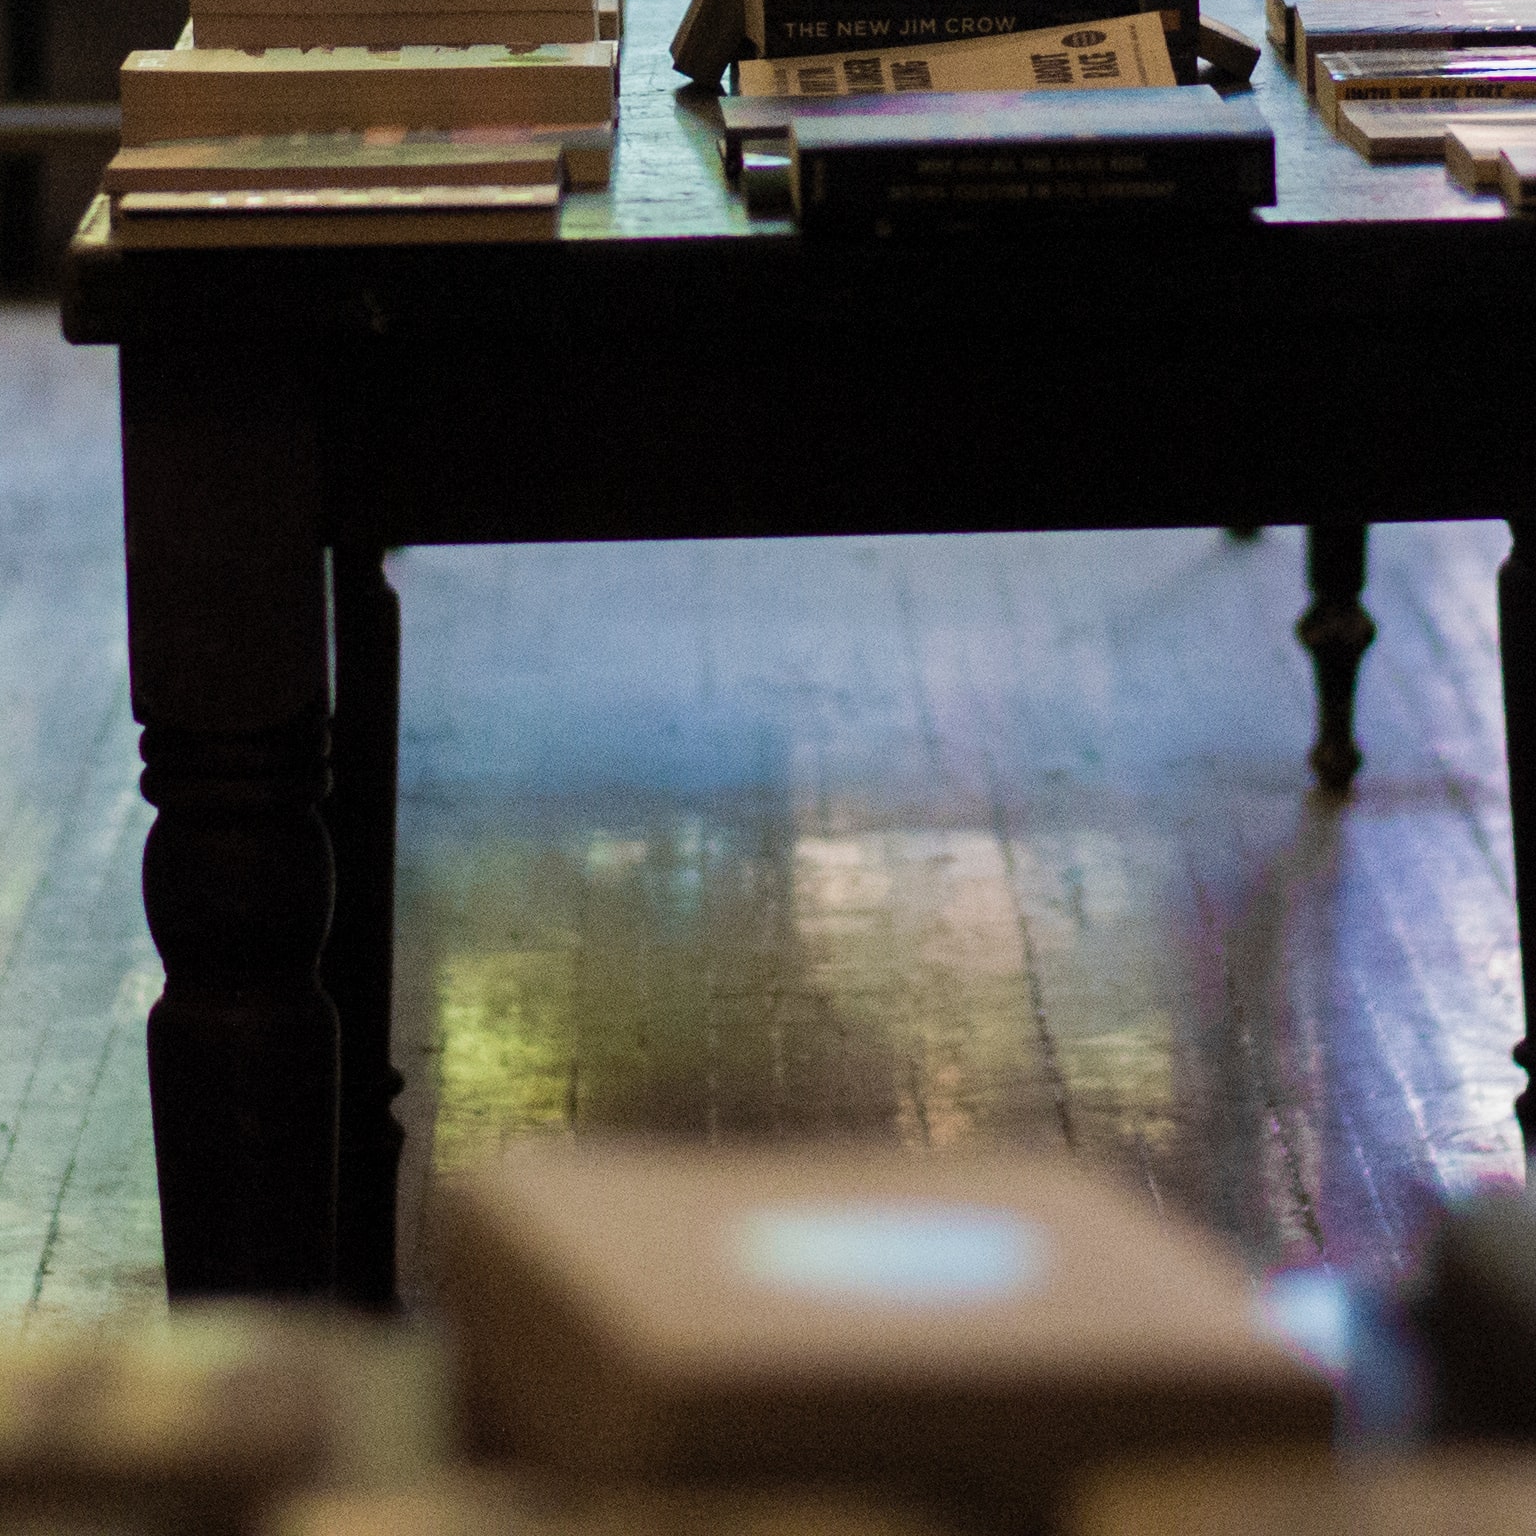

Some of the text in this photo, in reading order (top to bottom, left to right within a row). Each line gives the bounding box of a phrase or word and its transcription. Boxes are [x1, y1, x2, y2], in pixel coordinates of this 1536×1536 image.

[783, 16, 1017, 39] THE NEW JIM CROW
